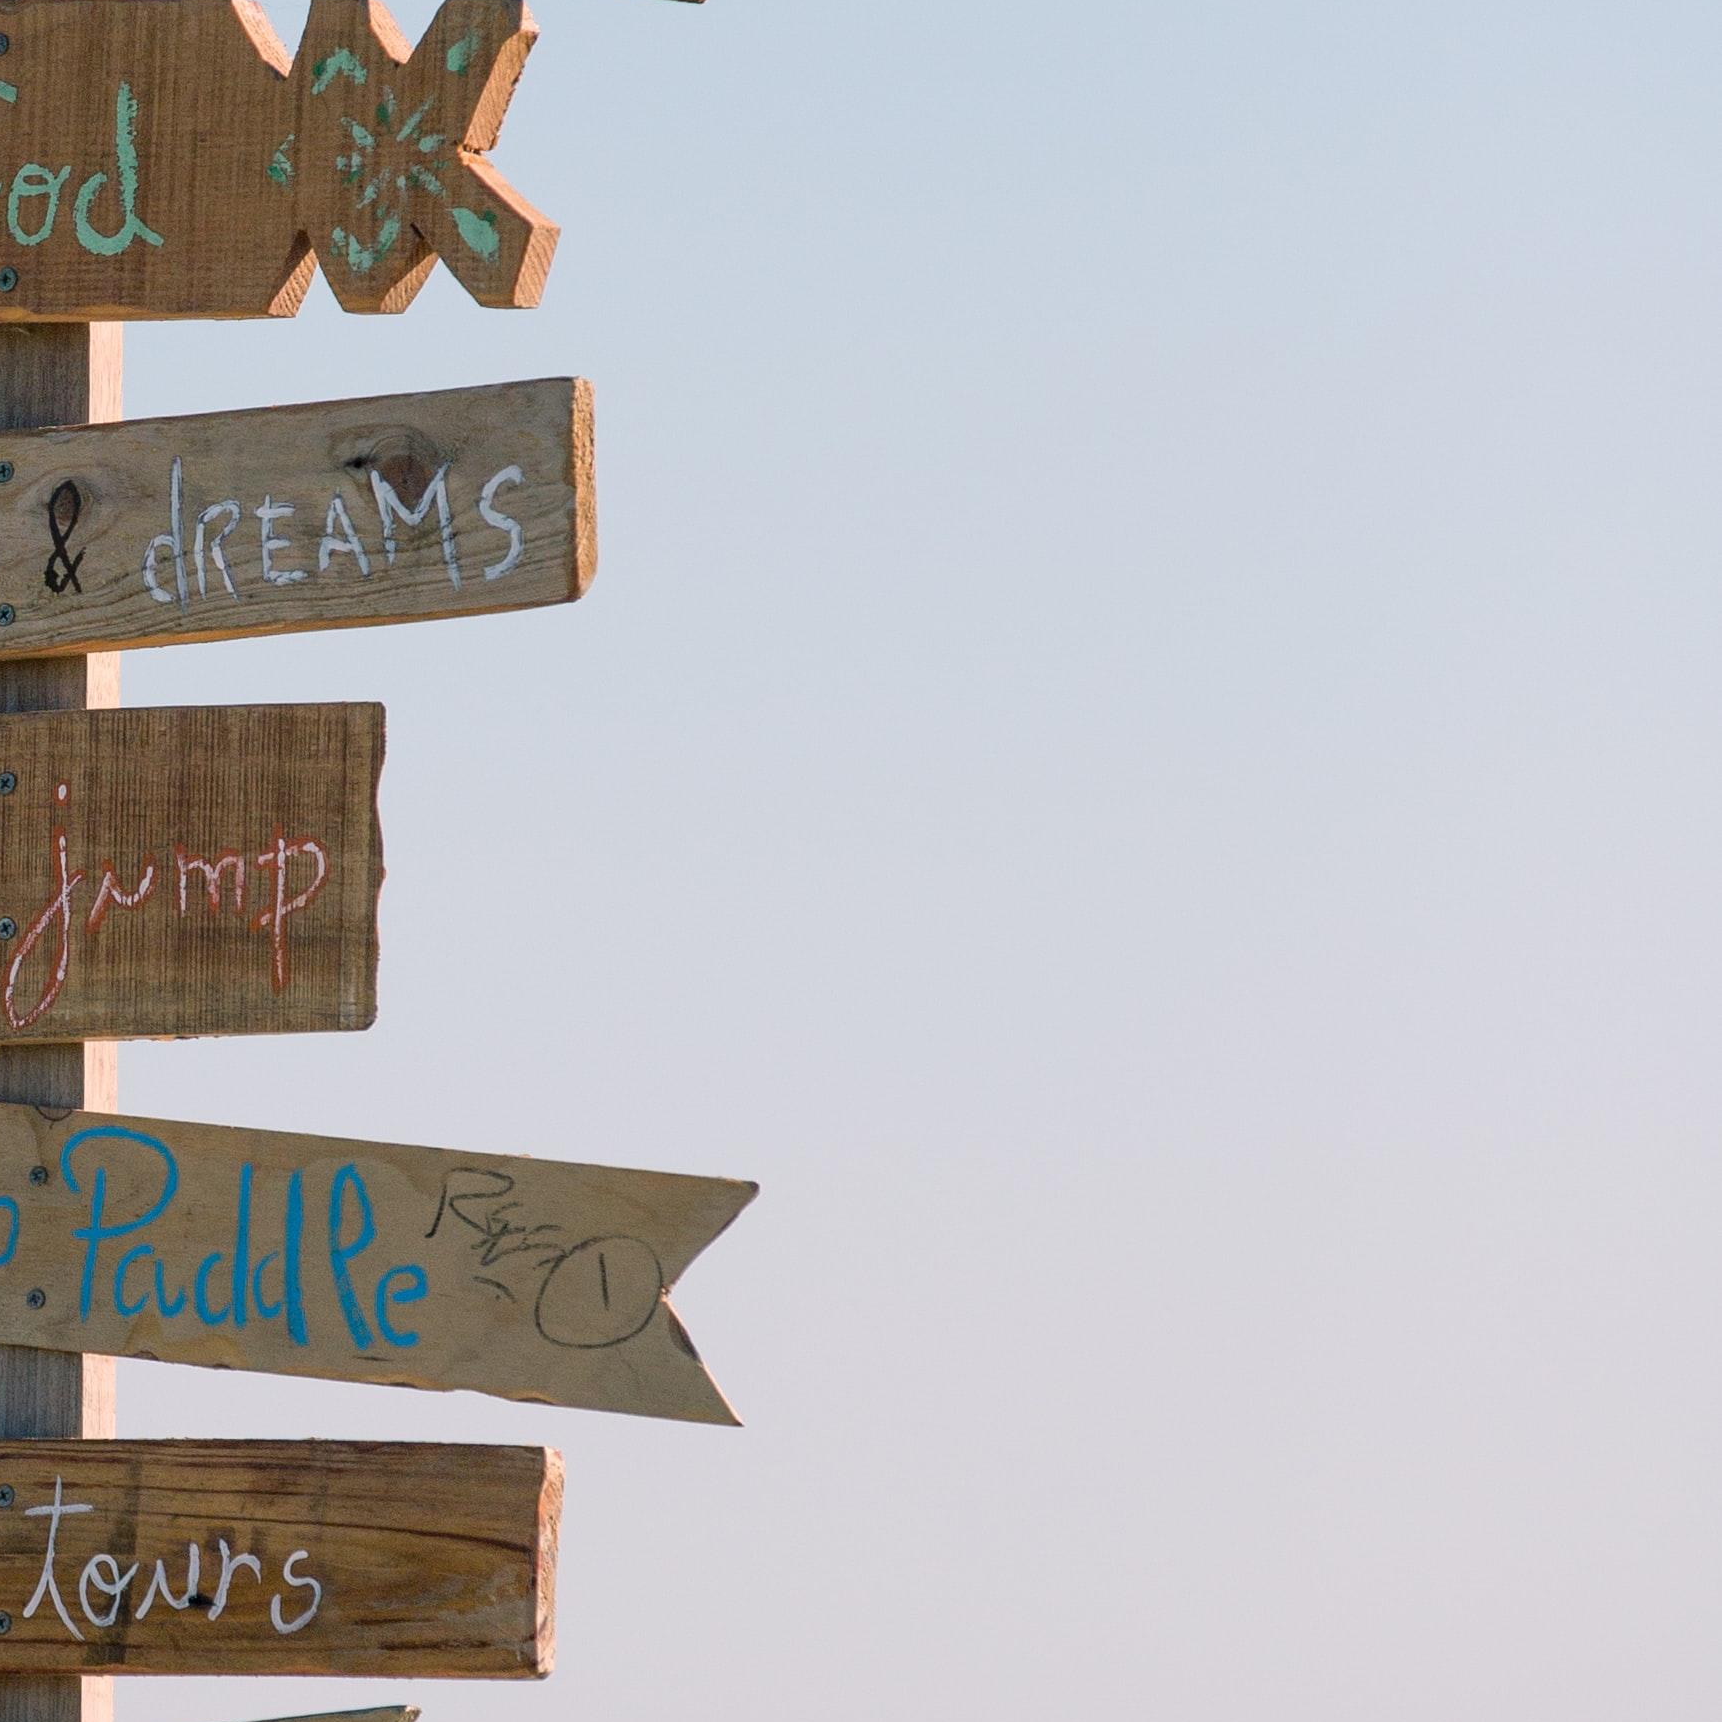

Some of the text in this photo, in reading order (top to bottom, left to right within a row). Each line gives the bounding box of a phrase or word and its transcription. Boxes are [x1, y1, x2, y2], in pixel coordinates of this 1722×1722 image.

[44, 480, 82, 595] &
[3, 782, 329, 1029] jump
[60, 1124, 430, 1351] Paddle
[23, 1476, 322, 1640] tours
